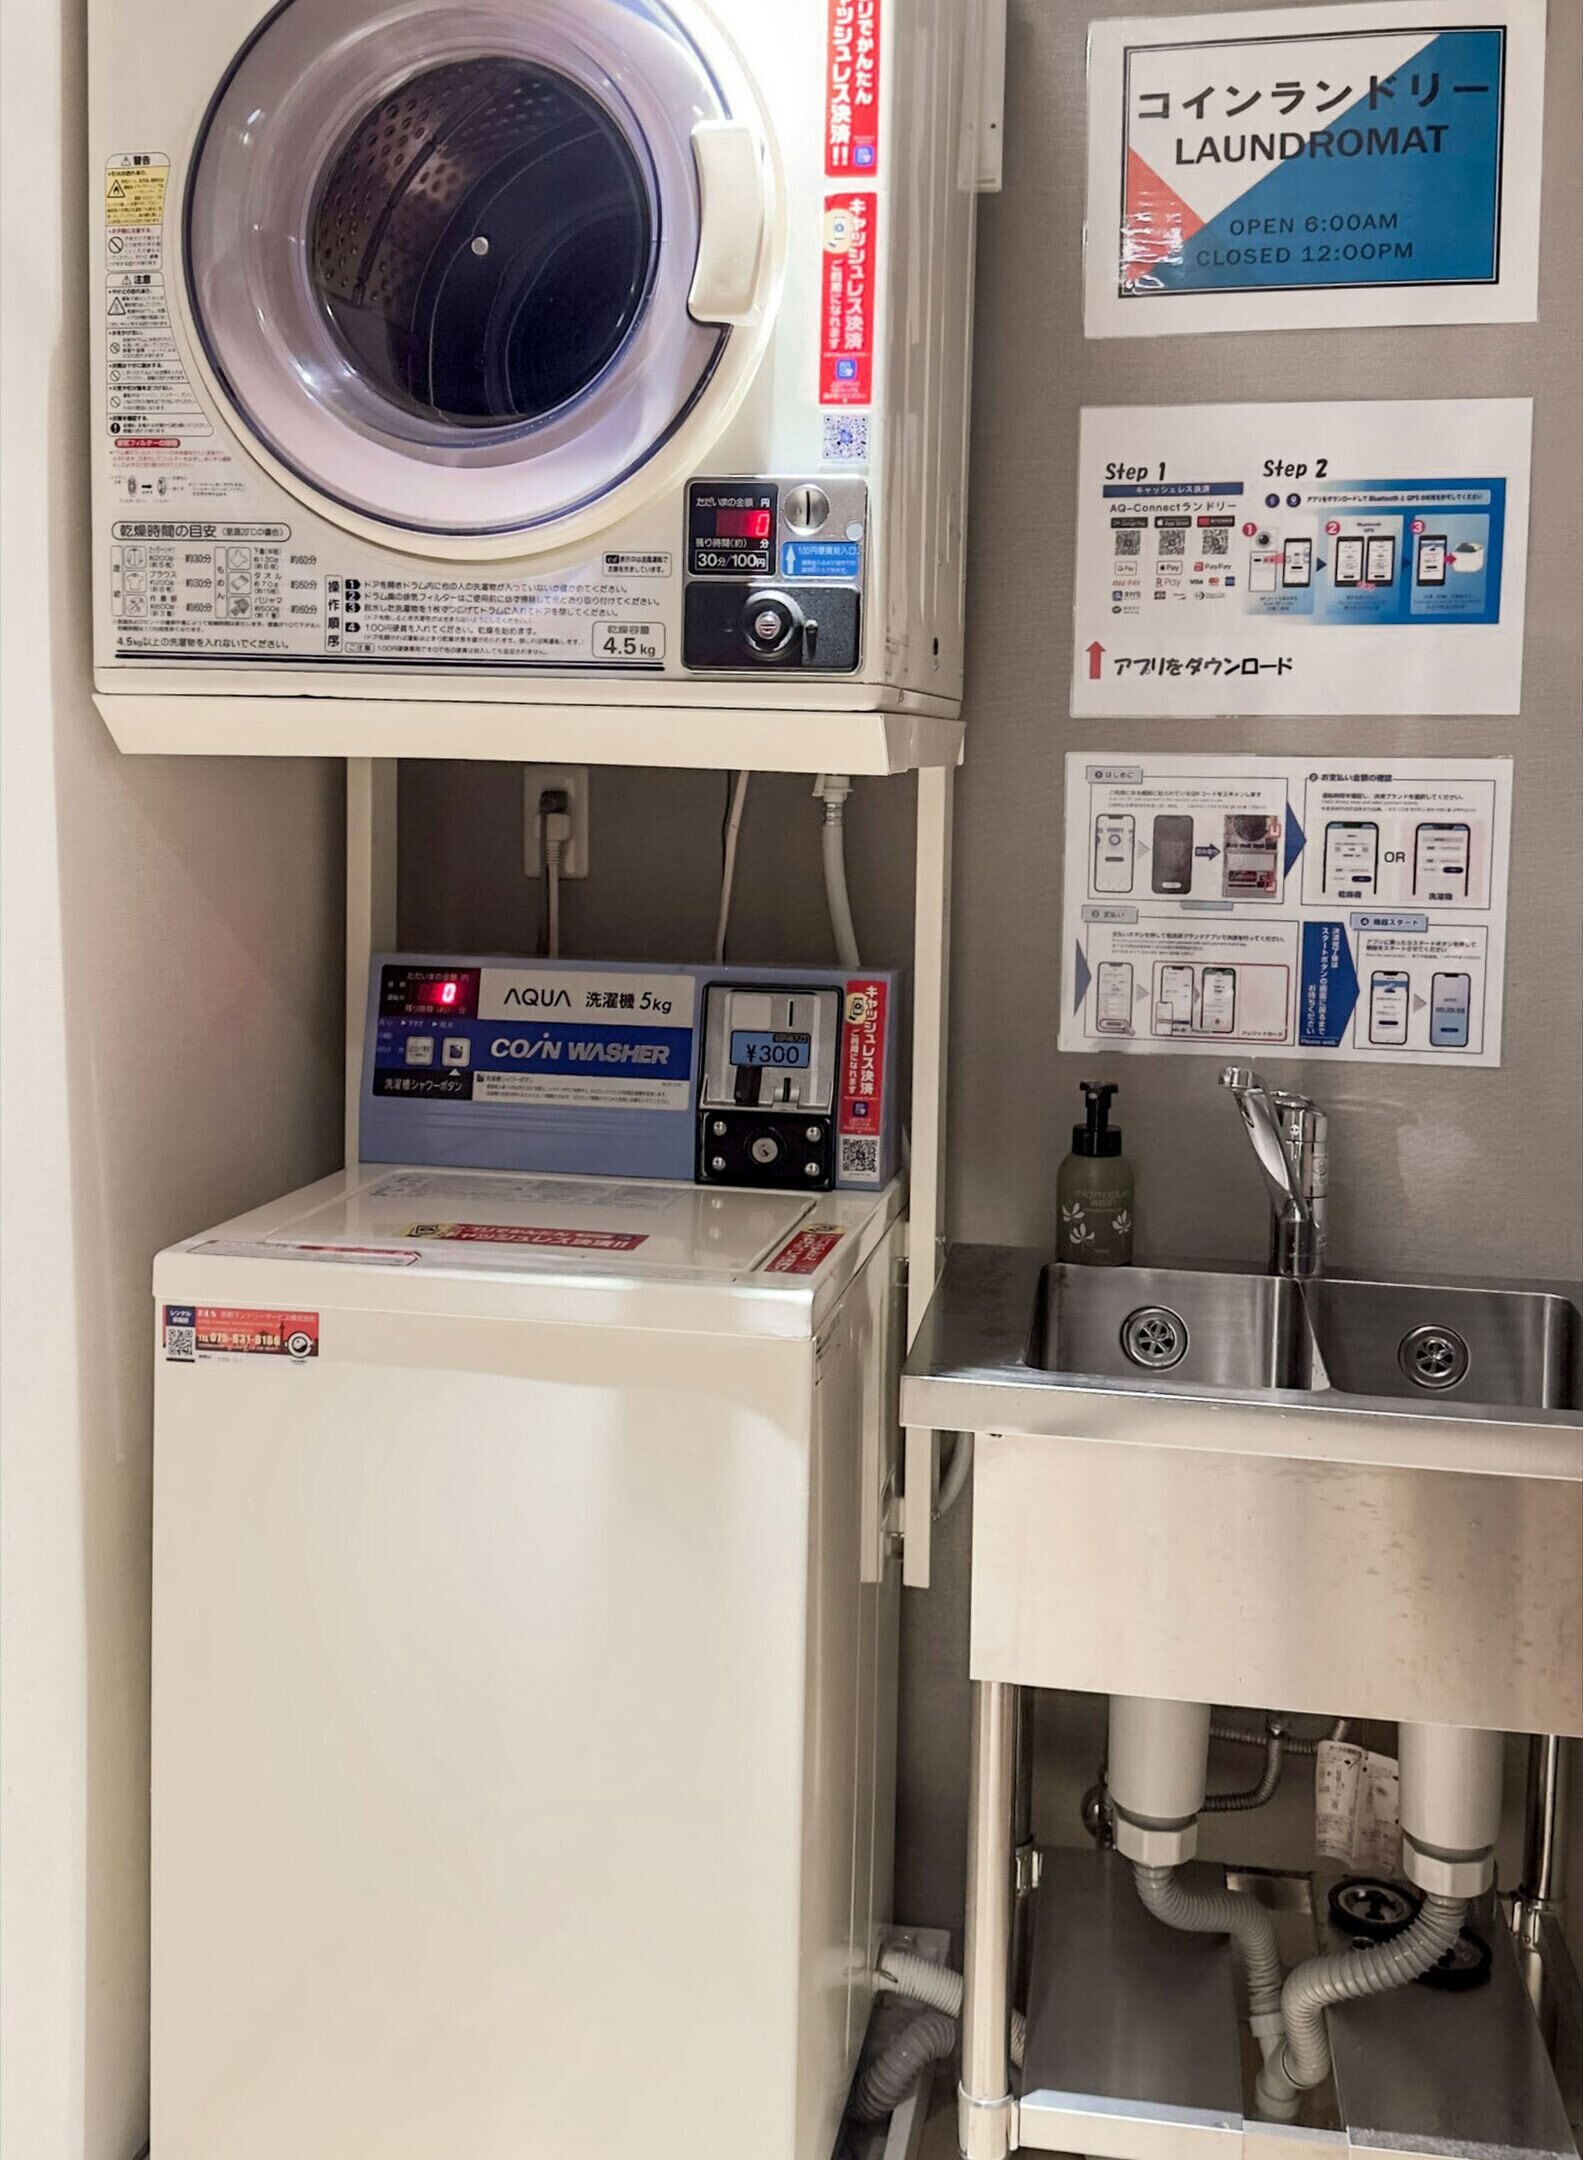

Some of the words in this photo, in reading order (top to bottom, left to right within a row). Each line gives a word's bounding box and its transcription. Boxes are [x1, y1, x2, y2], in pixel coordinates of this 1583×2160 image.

[1137, 72, 1491, 120] コインランドリー
[1175, 124, 1449, 166] LAUNDROMAT
[1229, 217, 1295, 236] OPEN
[1304, 213, 1399, 232] 6:00AM
[1196, 246, 1292, 267] CLOSED
[1301, 242, 1414, 263] 12:00PM
[134, 275, 151, 284] 注意
[844, 198, 867, 351] キャッシュレス決済
[1105, 462, 1148, 482] Step
[1158, 461, 1166, 481] 1
[1263, 460, 1309, 480] Step
[1315, 458, 1328, 478] 2
[1136, 485, 1210, 494] キャッシュレス決済
[695, 497, 754, 508] ただいまの金額
[760, 498, 770, 507] 円
[119, 524, 217, 538] 乾燥時間の目安
[755, 513, 771, 537] 0
[1327, 522, 1339, 533] 2
[1412, 522, 1424, 533] 3
[759, 538, 770, 549] 分
[328, 580, 340, 647] 操作順序
[607, 625, 650, 635] 乾燥容量
[602, 636, 637, 655] 4.5
[640, 643, 656, 657] kg
[1114, 657, 1294, 677] アプリをダウンロード
[1384, 851, 1406, 863] OR
[441, 982, 457, 1004] 0
[503, 987, 571, 1008] AQUA
[585, 991, 635, 1009] 洗濯機
[639, 991, 672, 1014] 5kg
[490, 1032, 562, 1061] COIN
[568, 1042, 671, 1065] WASHER
[860, 985, 878, 1095] キャッシュレス決済
[746, 1044, 799, 1064] ¥300
